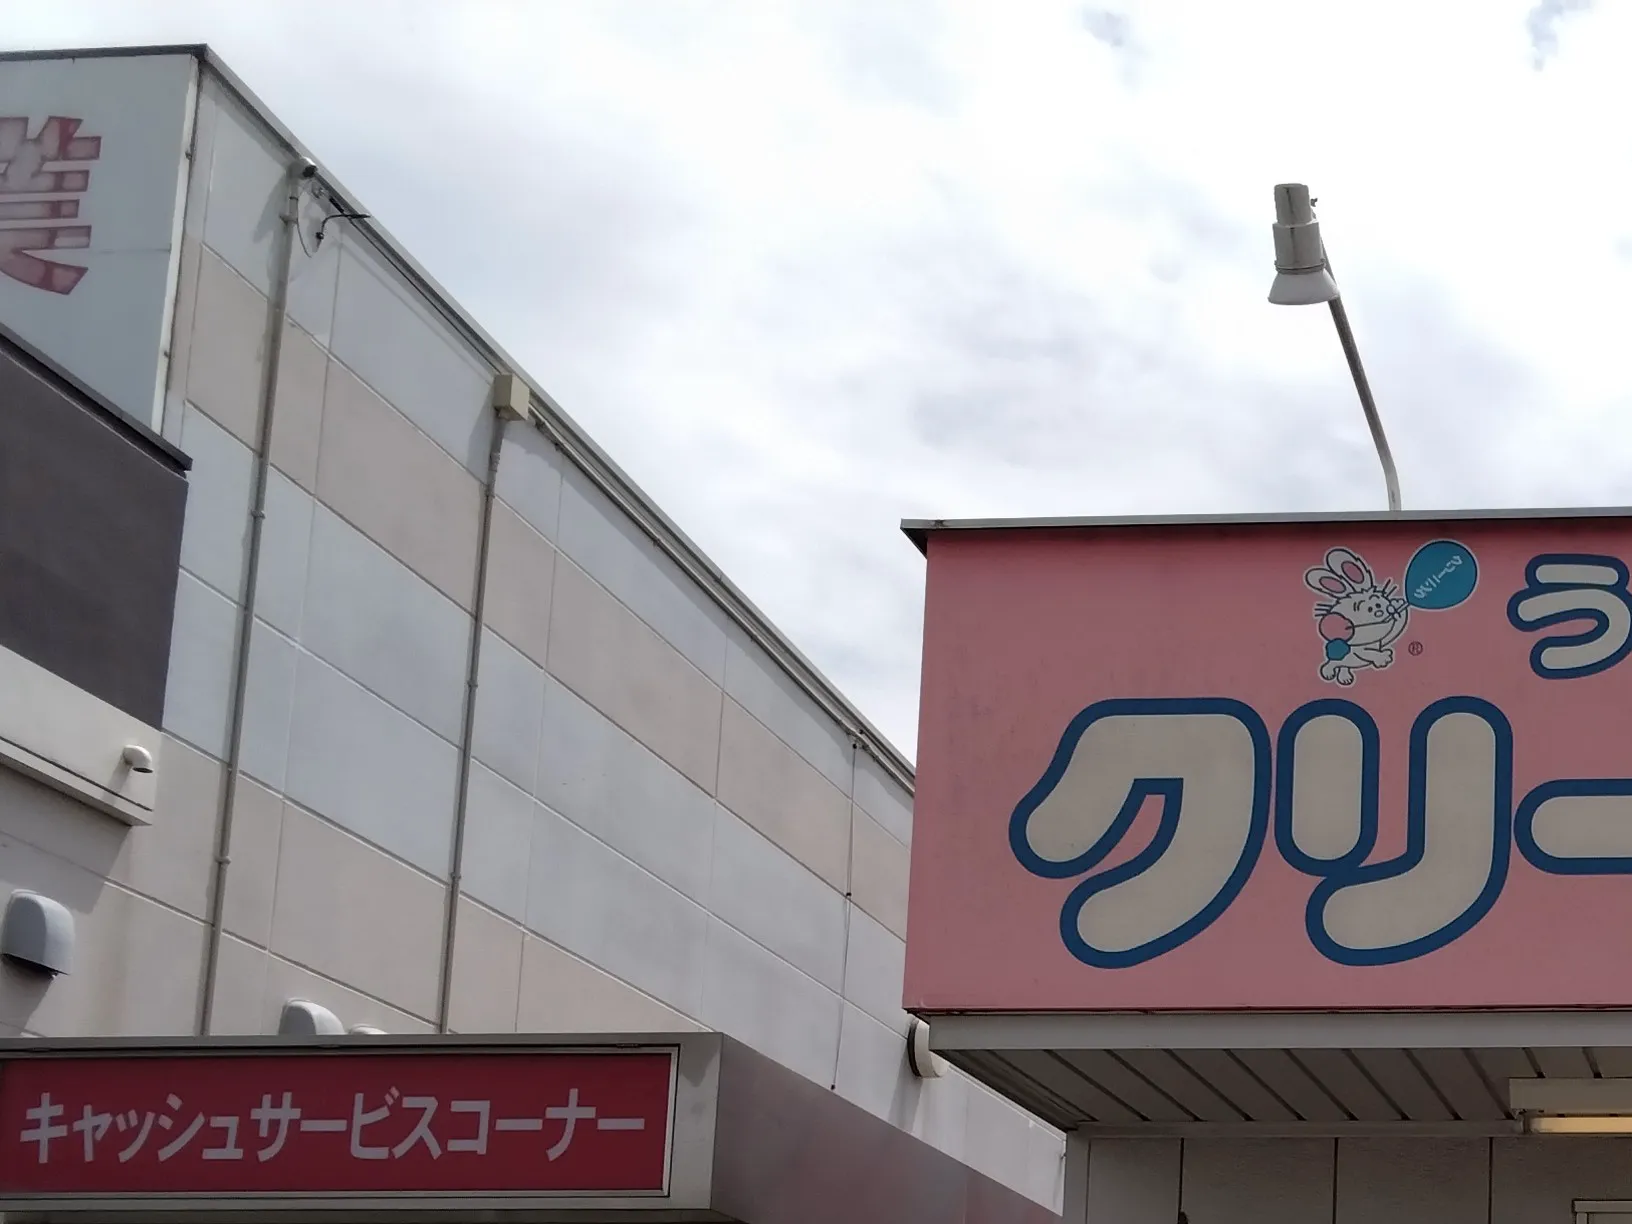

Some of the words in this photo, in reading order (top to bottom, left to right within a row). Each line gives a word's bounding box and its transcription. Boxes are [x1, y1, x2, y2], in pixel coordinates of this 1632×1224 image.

[19, 1086, 646, 1164] キャッシュサービスコーナー
